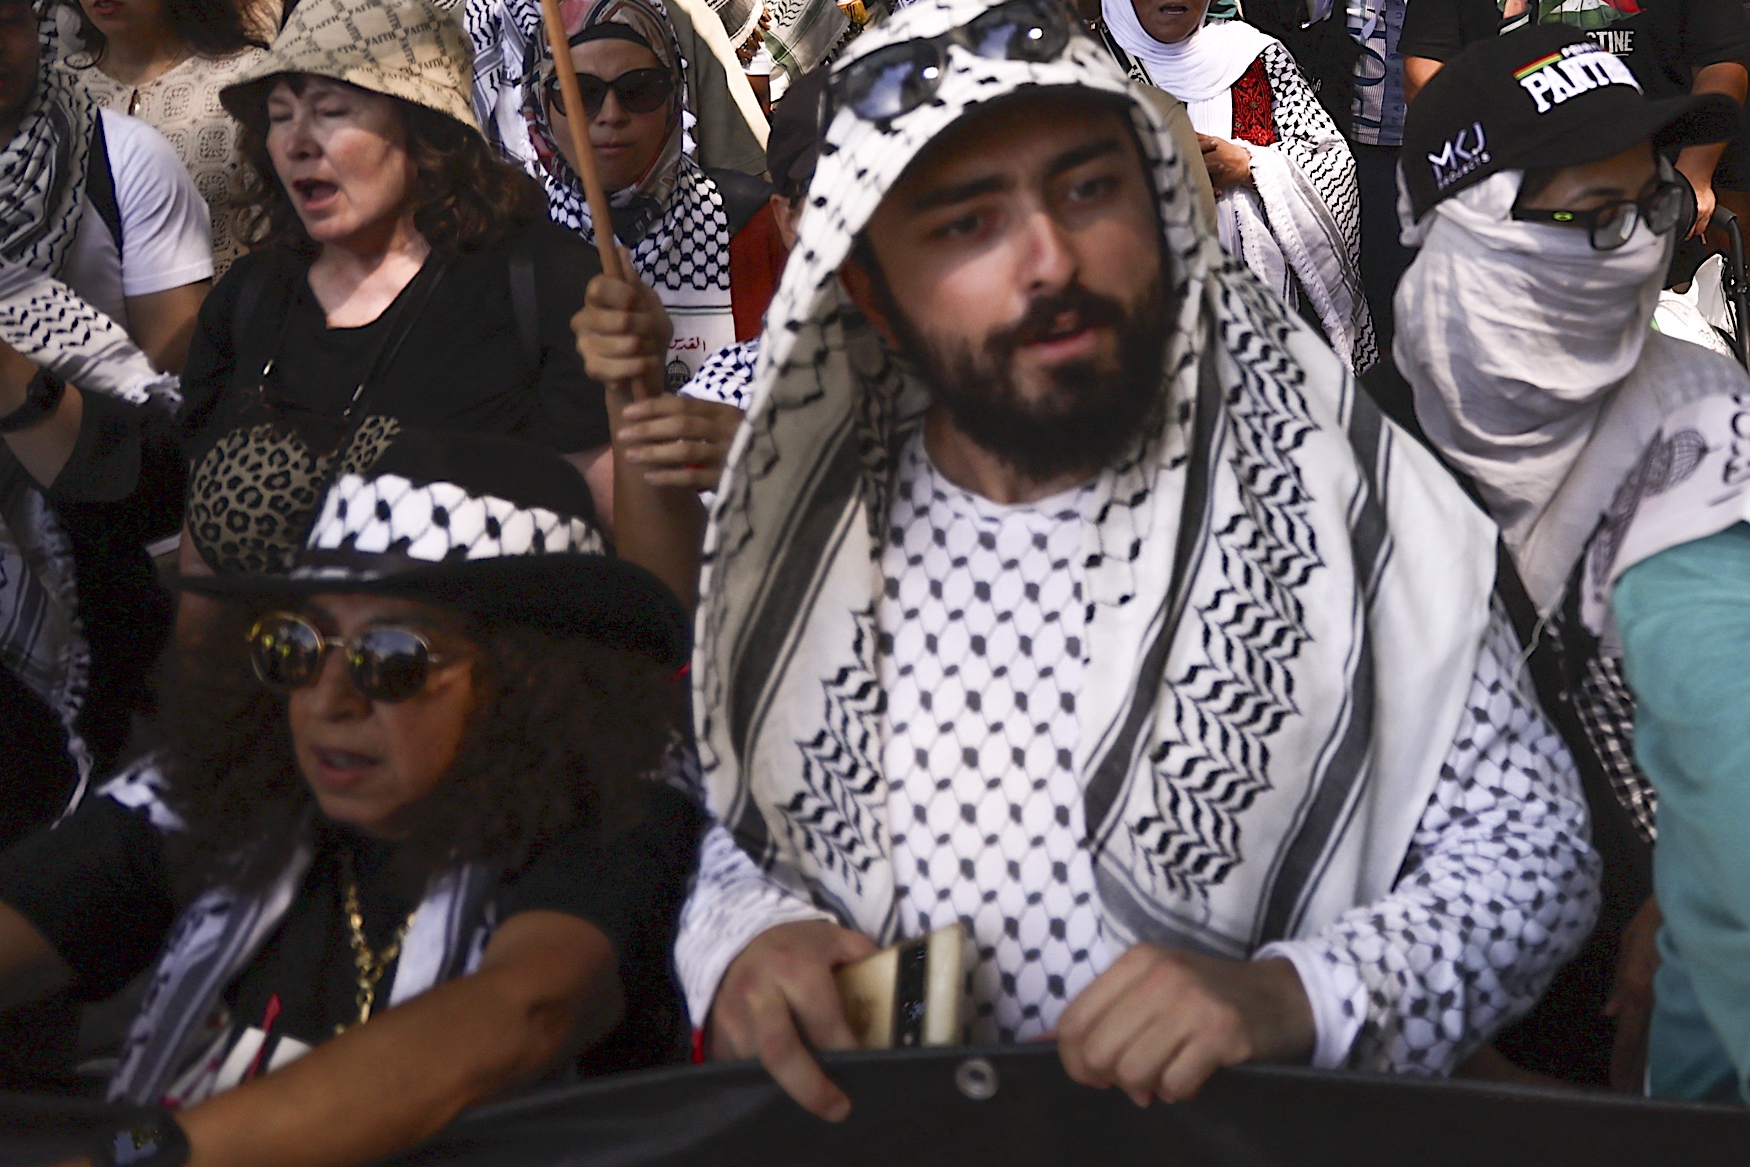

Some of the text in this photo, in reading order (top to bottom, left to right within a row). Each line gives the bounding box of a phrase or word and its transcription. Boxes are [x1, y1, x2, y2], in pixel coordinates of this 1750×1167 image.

[404, 22, 431, 36] FAITH
[365, 31, 396, 46] FAITH
[418, 58, 443, 70] FAITH
